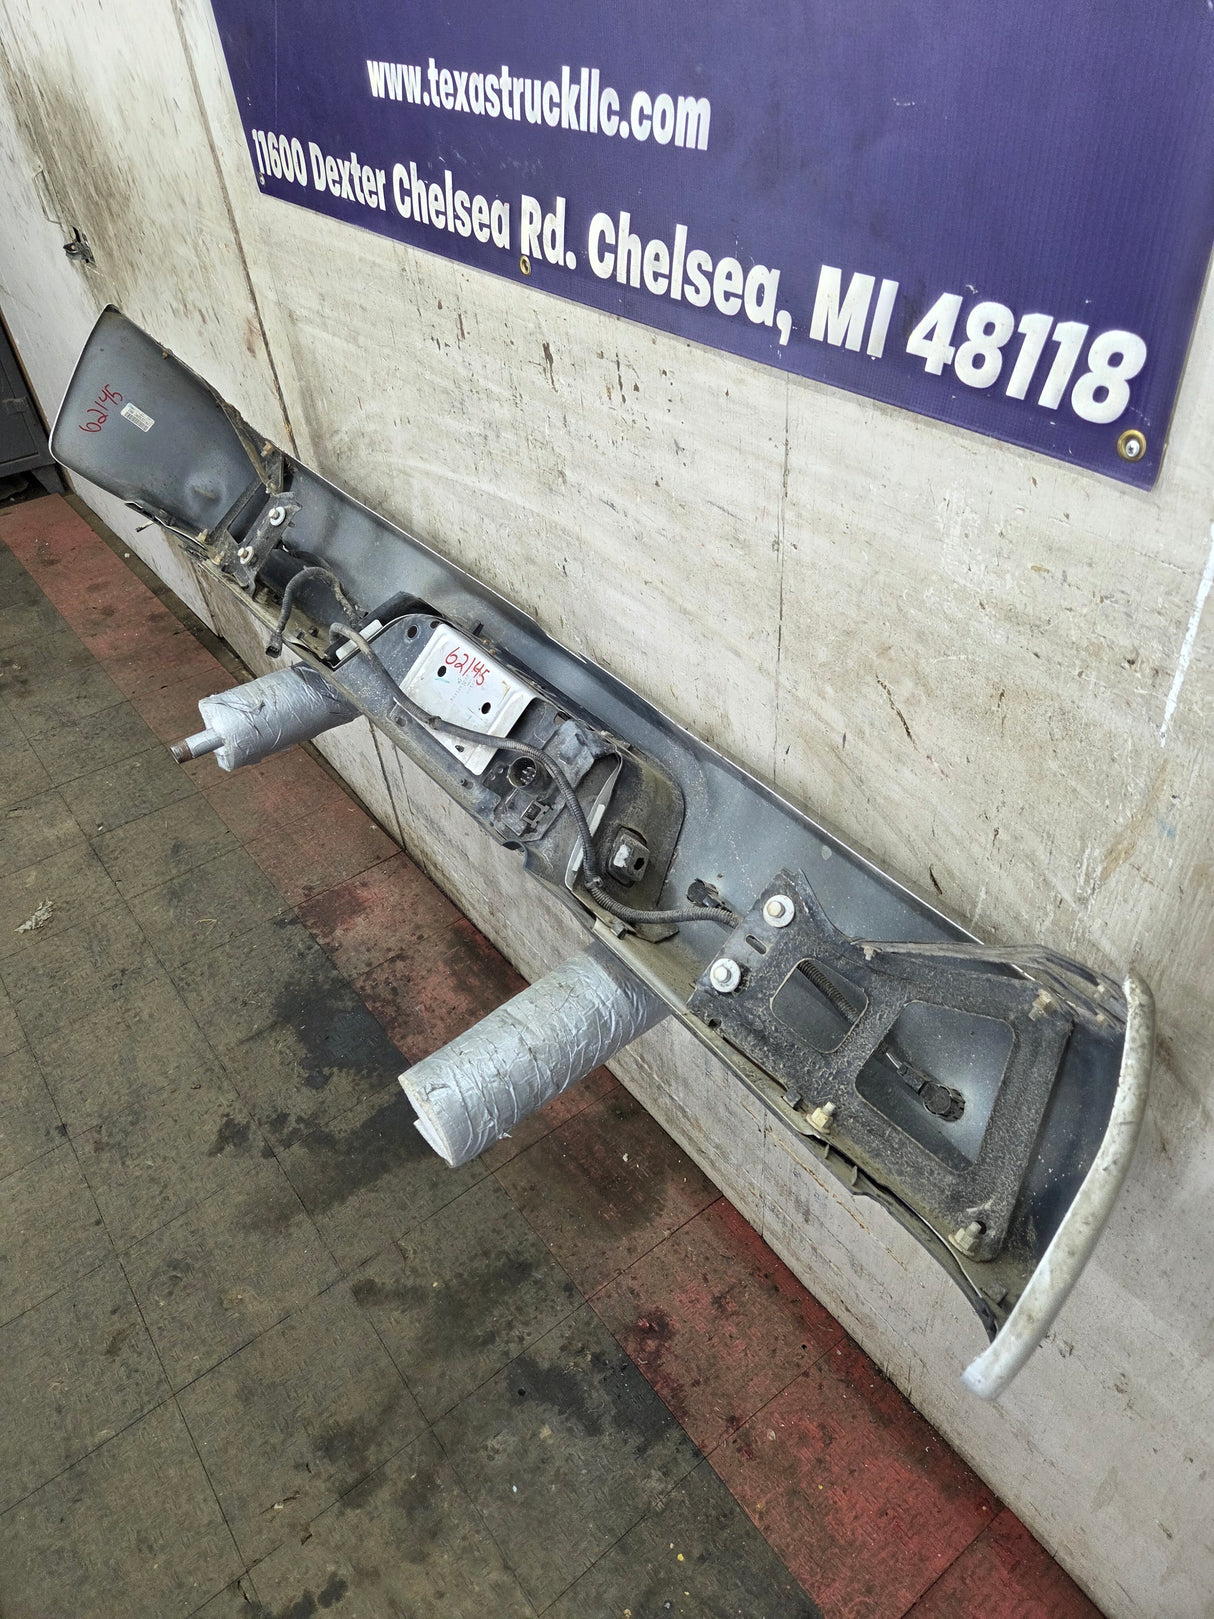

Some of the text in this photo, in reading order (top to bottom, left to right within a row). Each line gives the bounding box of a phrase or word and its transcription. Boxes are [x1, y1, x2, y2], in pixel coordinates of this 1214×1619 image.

[367, 58, 710, 151] www.texastruckllc.com
[251, 129, 1147, 424] 11600 Dexter Chelsea Rd. Chelsea, MI 48118
[79, 384, 123, 432] 62145
[445, 646, 490, 686] 62145
